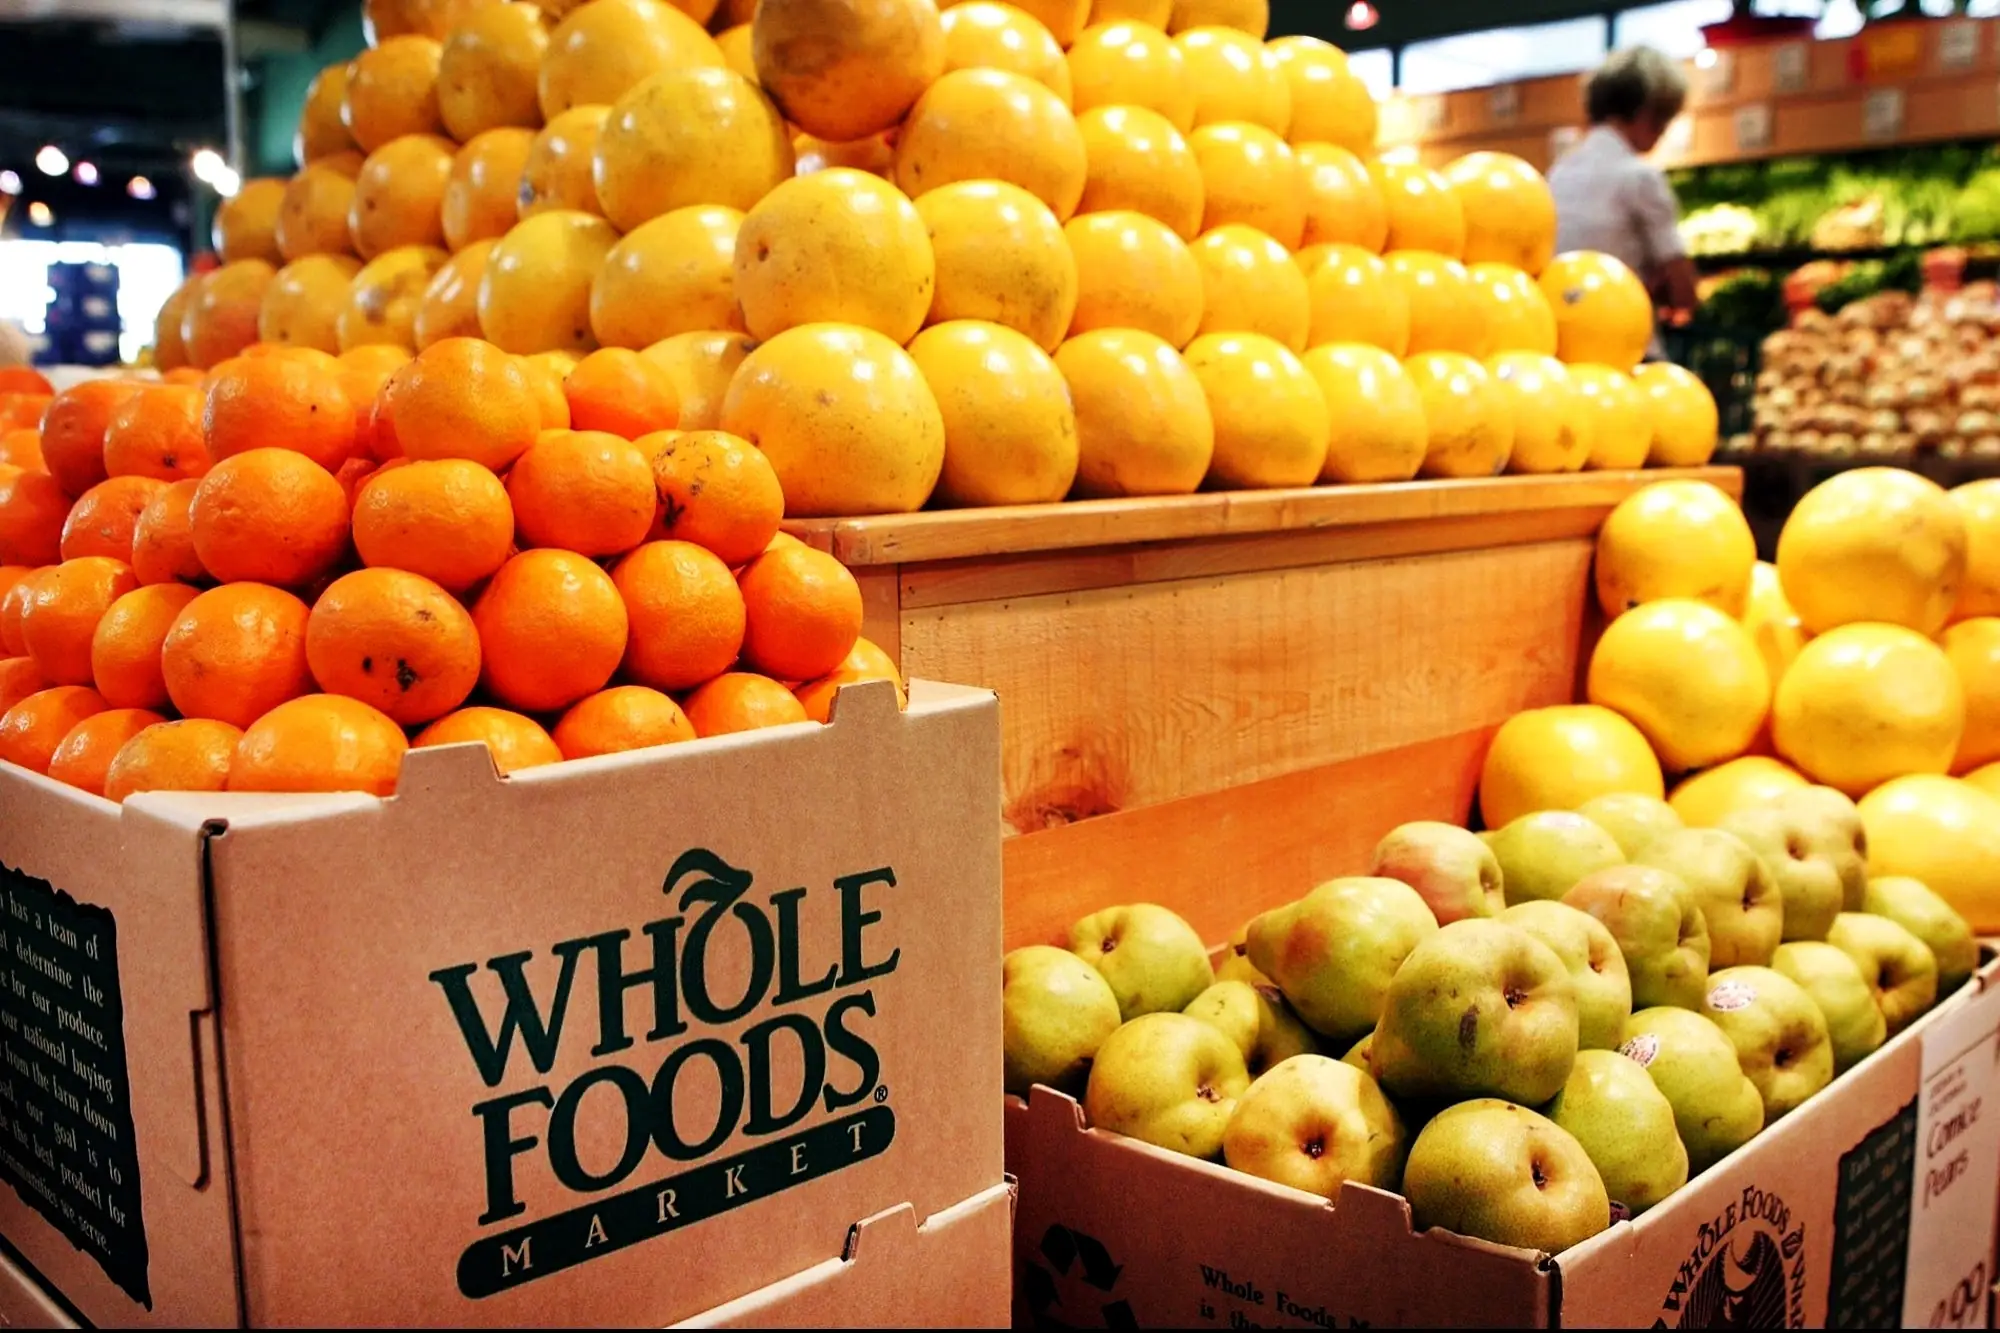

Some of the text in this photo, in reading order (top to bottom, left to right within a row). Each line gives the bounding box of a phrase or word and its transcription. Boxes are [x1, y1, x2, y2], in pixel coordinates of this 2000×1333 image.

[10, 891, 28, 923] has
[34, 912, 42, 931] a
[49, 914, 77, 949] team
[86, 934, 99, 961] of
[11, 970, 27, 999] for
[32, 989, 50, 1014] our
[57, 1005, 108, 1052] produce.
[16, 936, 73, 989] determine
[82, 974, 104, 1008] the
[429, 866, 900, 1087] WHOLE
[2, 1009, 113, 1104] our national buying
[5, 1040, 117, 1142] from the farm down
[13, 1120, 29, 1149] the
[60, 1162, 103, 1210] product
[108, 1194, 126, 1228] for
[26, 1100, 44, 1126] our
[54, 1121, 77, 1152] goal
[86, 1140, 98, 1168] is
[108, 1158, 122, 1185] to
[60, 1199, 76, 1224] we
[78, 1216, 111, 1255] serve.
[502, 1120, 868, 1278] MARKET
[1663, 1202, 1737, 1311] WHOLE
[1739, 1184, 1791, 1235] FOODS
[1199, 1263, 1337, 1329] Whole Foods
[1200, 1297, 1215, 1320] is
